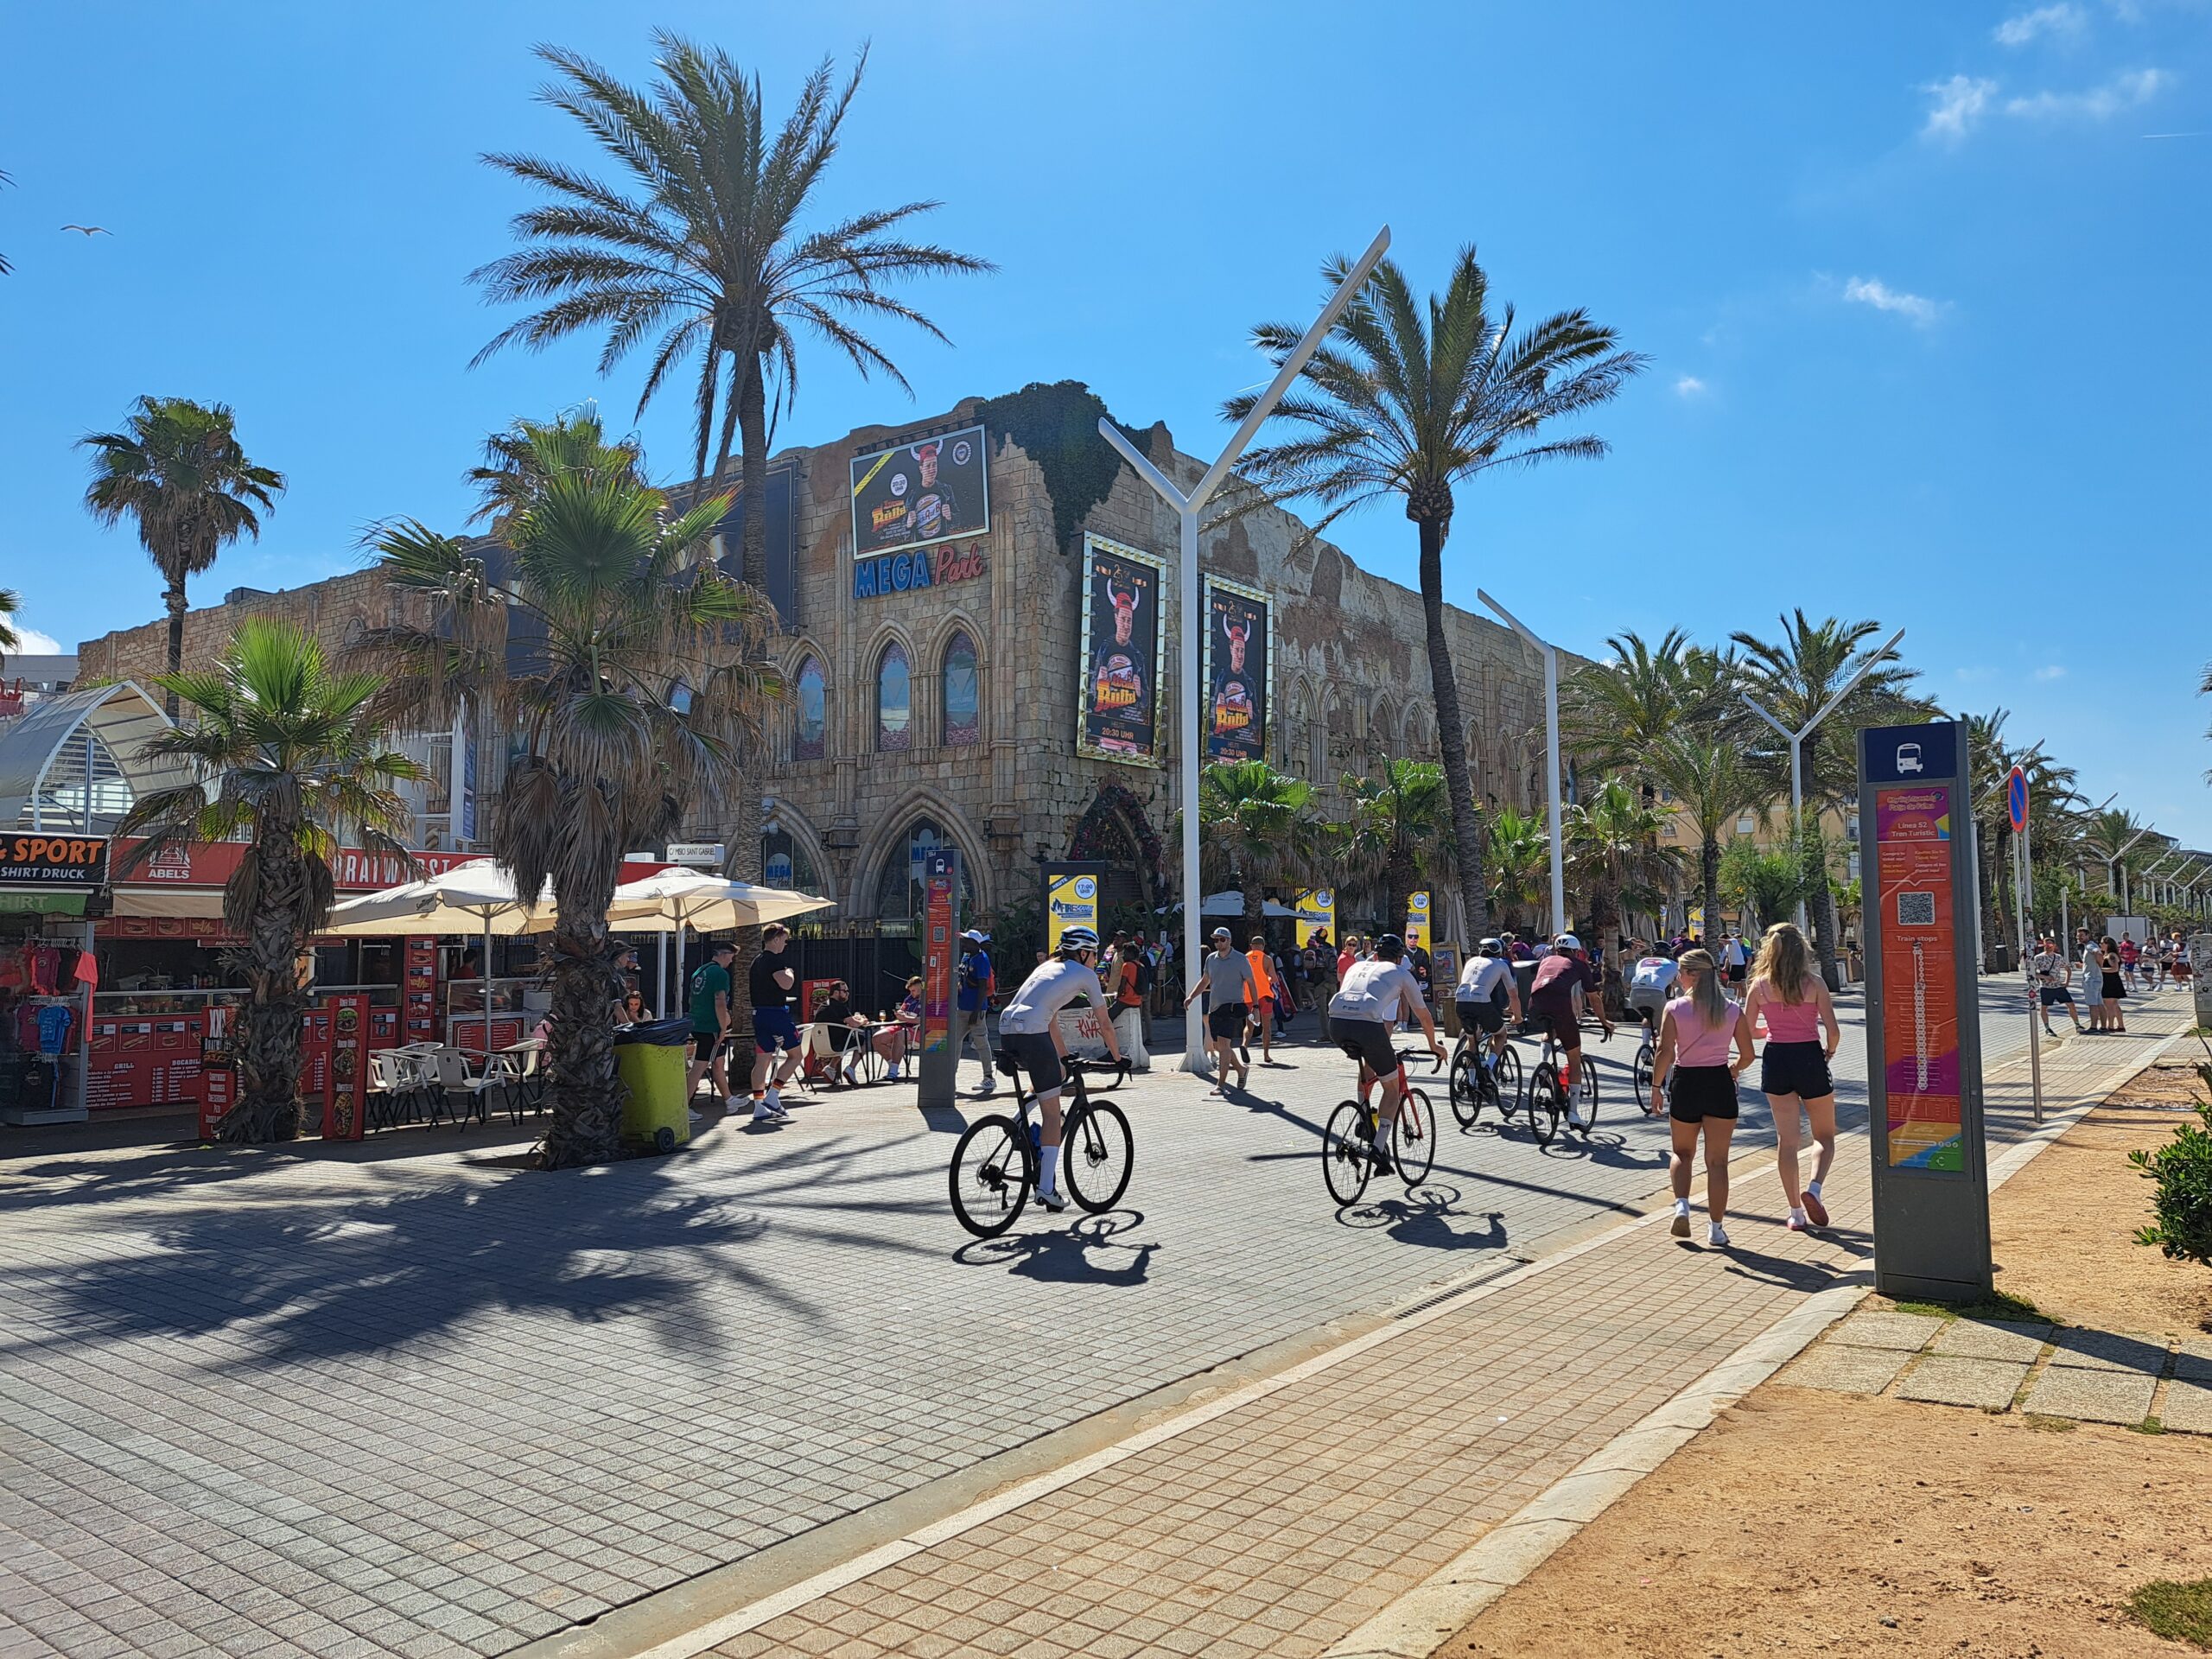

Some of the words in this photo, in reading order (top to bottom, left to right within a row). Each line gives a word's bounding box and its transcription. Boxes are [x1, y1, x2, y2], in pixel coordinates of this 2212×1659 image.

[854, 550, 931, 600] MEGA
[934, 542, 983, 587] Park
[1102, 727, 1120, 737] 20:30
[1121, 730, 1134, 740] UHR
[1219, 747, 1236, 756] 20:30
[13, 838, 104, 864] SPORT
[0, 867, 39, 878] SHIRT
[41, 868, 86, 879] DRUCK
[766, 865, 791, 878] MEGA
[172, 1058, 201, 1066] BOCADIL
